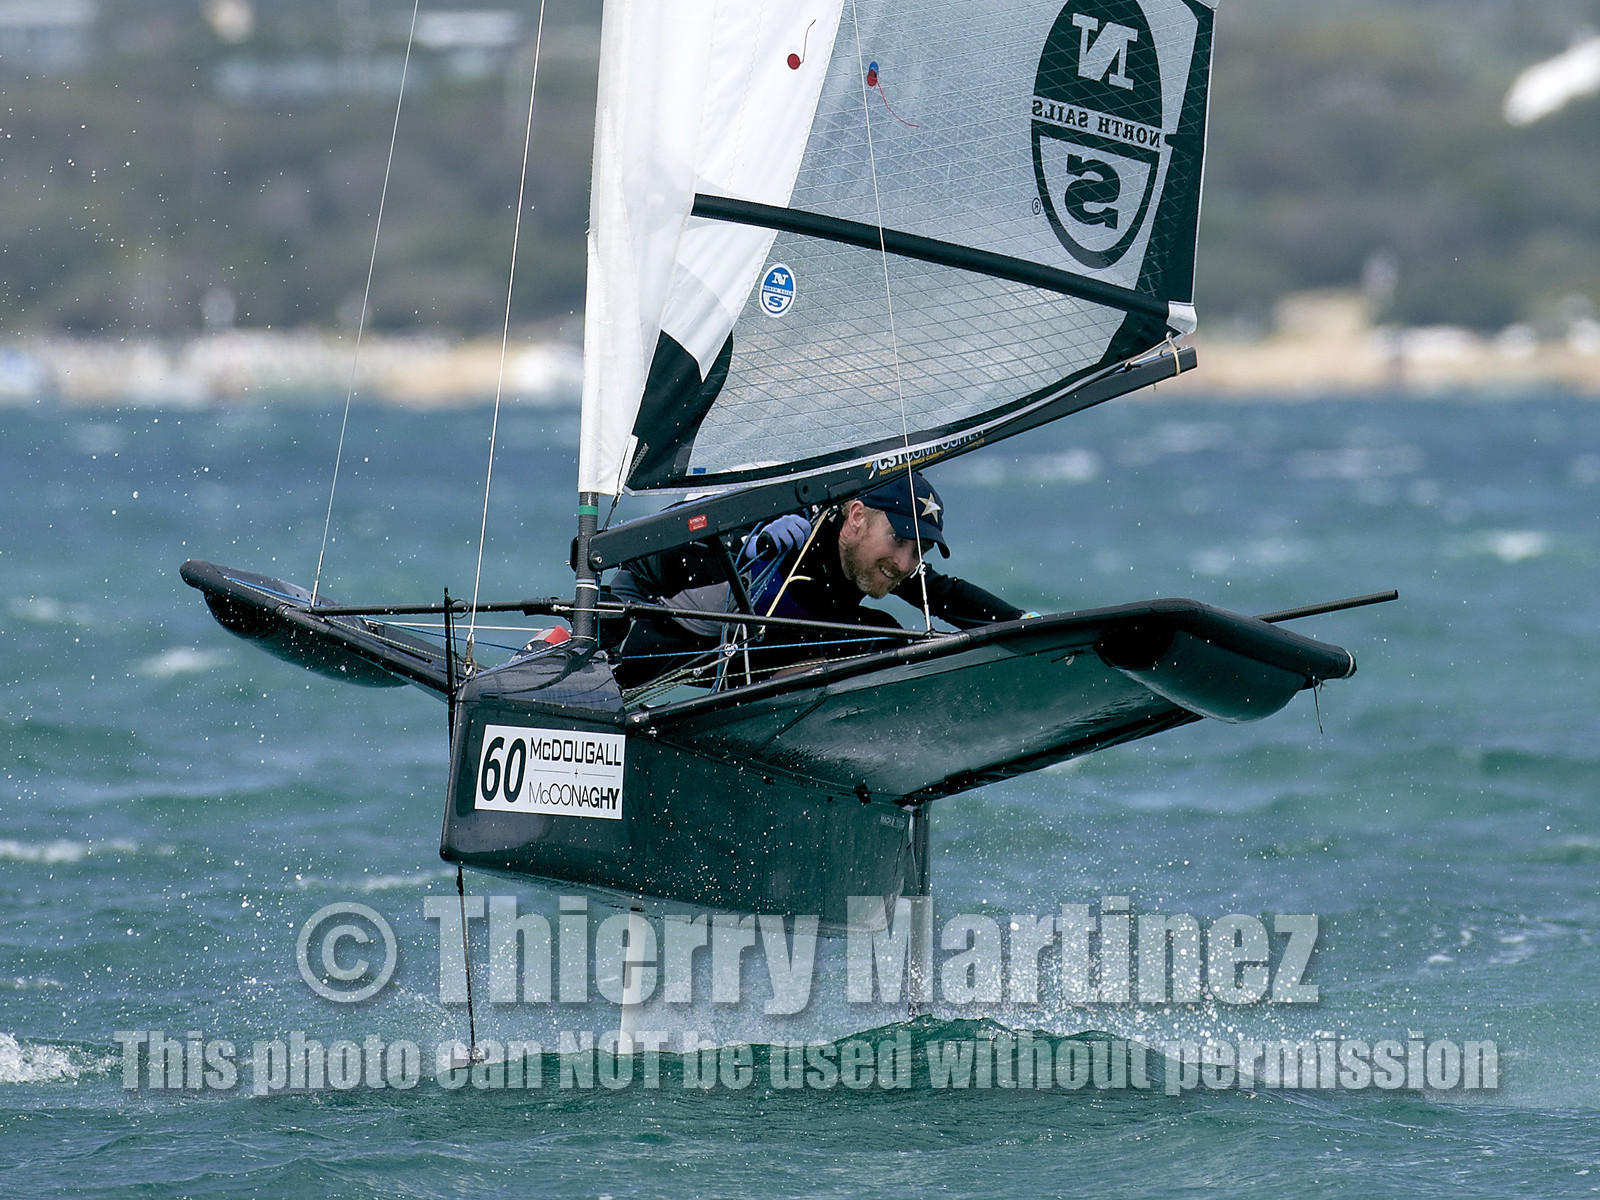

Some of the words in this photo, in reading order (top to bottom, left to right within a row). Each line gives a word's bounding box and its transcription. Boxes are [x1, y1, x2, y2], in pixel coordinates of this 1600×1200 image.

[771, 272, 789, 286] N
[768, 296, 783, 307] S
[481, 736, 527, 803] 60
[530, 737, 621, 766] McDOUGALL
[529, 781, 620, 810] McCONAGHY
